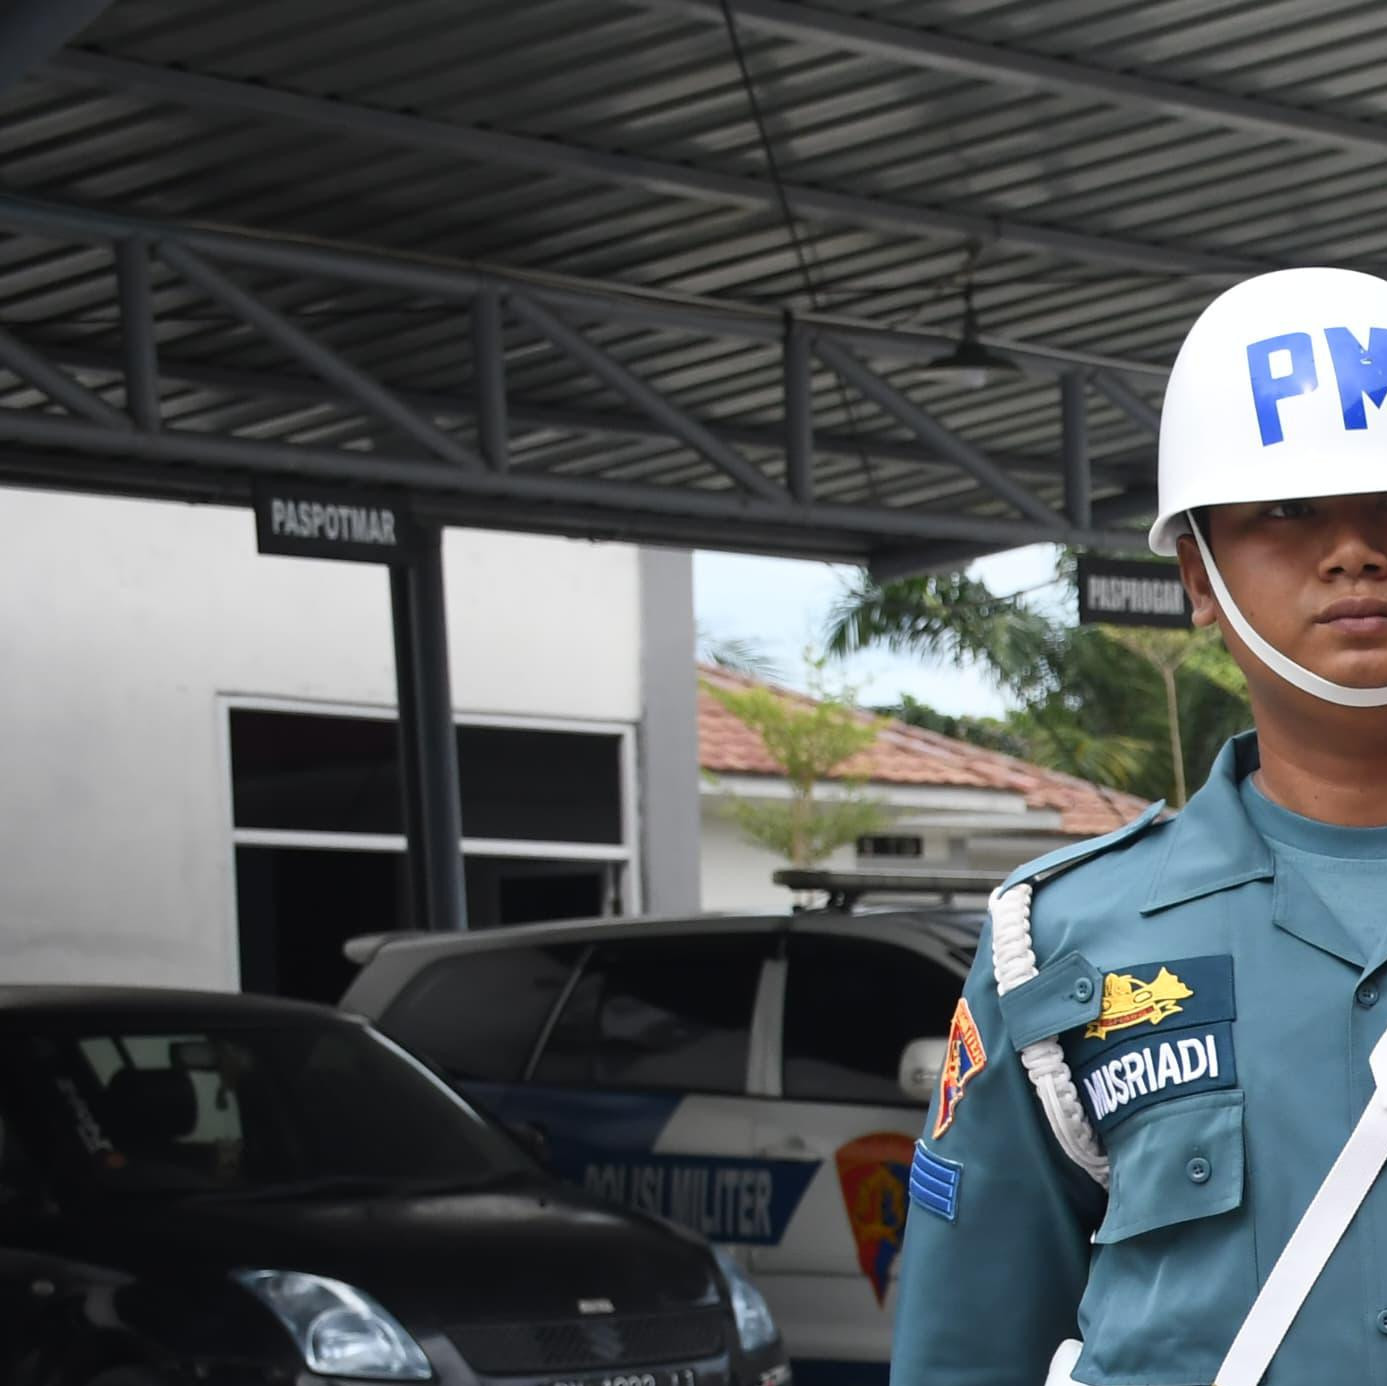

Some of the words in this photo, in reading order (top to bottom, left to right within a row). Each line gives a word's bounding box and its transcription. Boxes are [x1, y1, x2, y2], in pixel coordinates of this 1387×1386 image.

[271, 498, 397, 547] PASPOTMAR
[1083, 1034, 1219, 1121] MUSRIADI
[670, 1164, 773, 1237] MILITER
